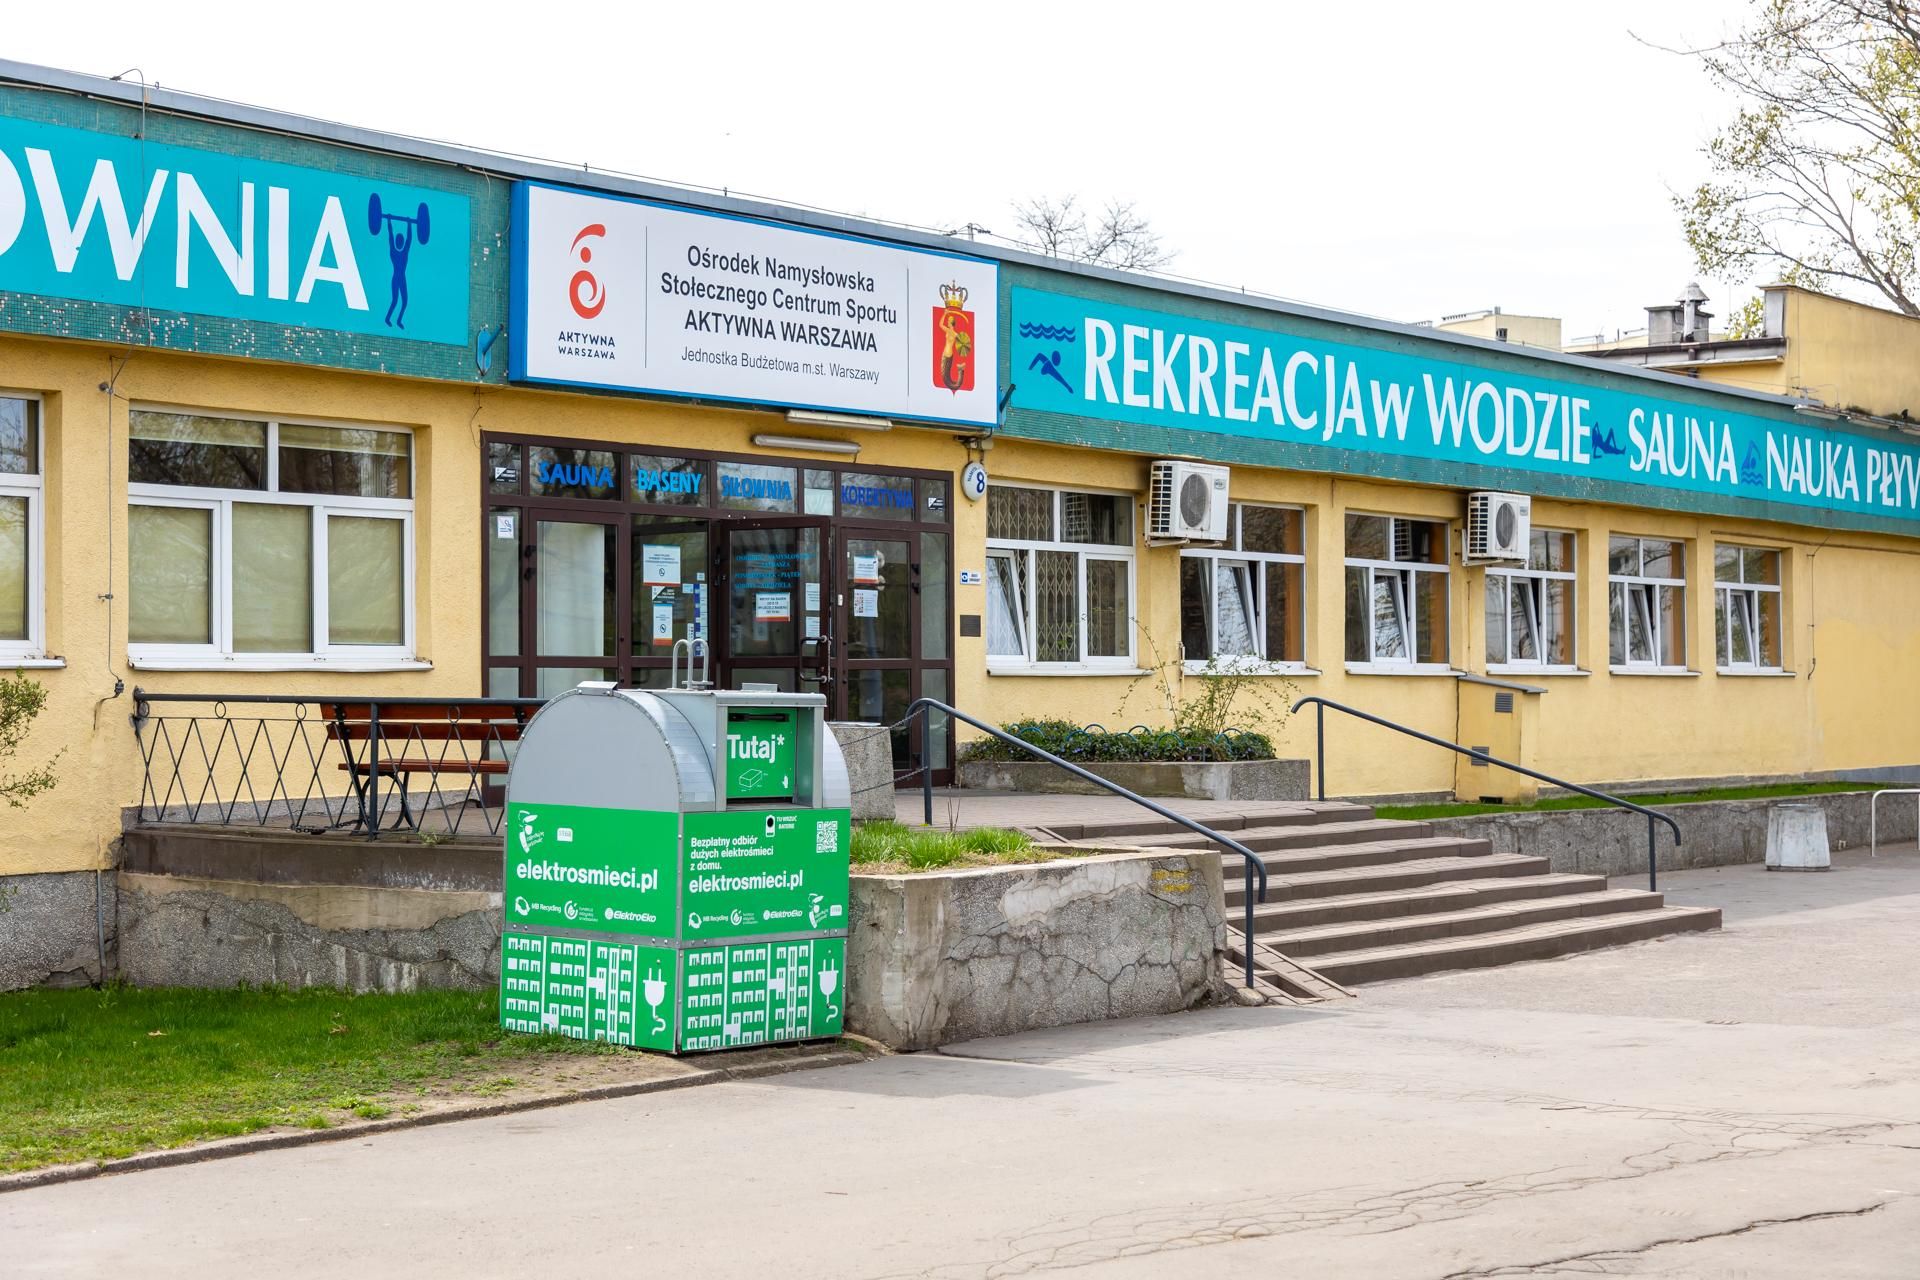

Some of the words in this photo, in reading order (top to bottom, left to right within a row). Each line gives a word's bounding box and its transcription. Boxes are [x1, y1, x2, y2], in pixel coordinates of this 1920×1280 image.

[0, 146, 370, 311] WNIA
[687, 245, 760, 277] Ośrodek
[765, 256, 875, 293] Namysłowska
[660, 271, 768, 311] Stołecznego
[772, 287, 841, 317] Centrum
[845, 298, 897, 325] Sportu
[558, 331, 616, 347] AKTYWNA
[684, 309, 777, 340] AKTYWNA
[780, 320, 878, 353] WARSZAWA
[558, 345, 616, 360] WARSZAWA
[681, 346, 738, 367] Jednostka
[741, 353, 799, 374] Budżetowa
[802, 361, 826, 377] m.st.
[829, 363, 880, 385] Warszawy
[1085, 317, 1367, 441] REKREACJA
[1423, 373, 1590, 464] WODZIE
[1628, 407, 1739, 485] SAUNA
[1766, 431, 1860, 502] NAUKA
[537, 460, 615, 488] SAUNA
[637, 468, 702, 495] BASENY
[721, 474, 793, 501] SIŁOWNIA
[976, 471, 985, 494] 8
[690, 837, 730, 849] Bezpłatny
[732, 835, 758, 846] odbiór
[690, 848, 719, 861] dużych
[721, 845, 774, 859] elektrośmieci
[516, 858, 658, 893] elektrosmieci.pl
[689, 863, 696, 871] z
[697, 860, 722, 871] domu.
[688, 869, 804, 894] elektrosmieci.pl
[540, 903, 561, 914] Recycling
[613, 910, 657, 923] ElektroEko
